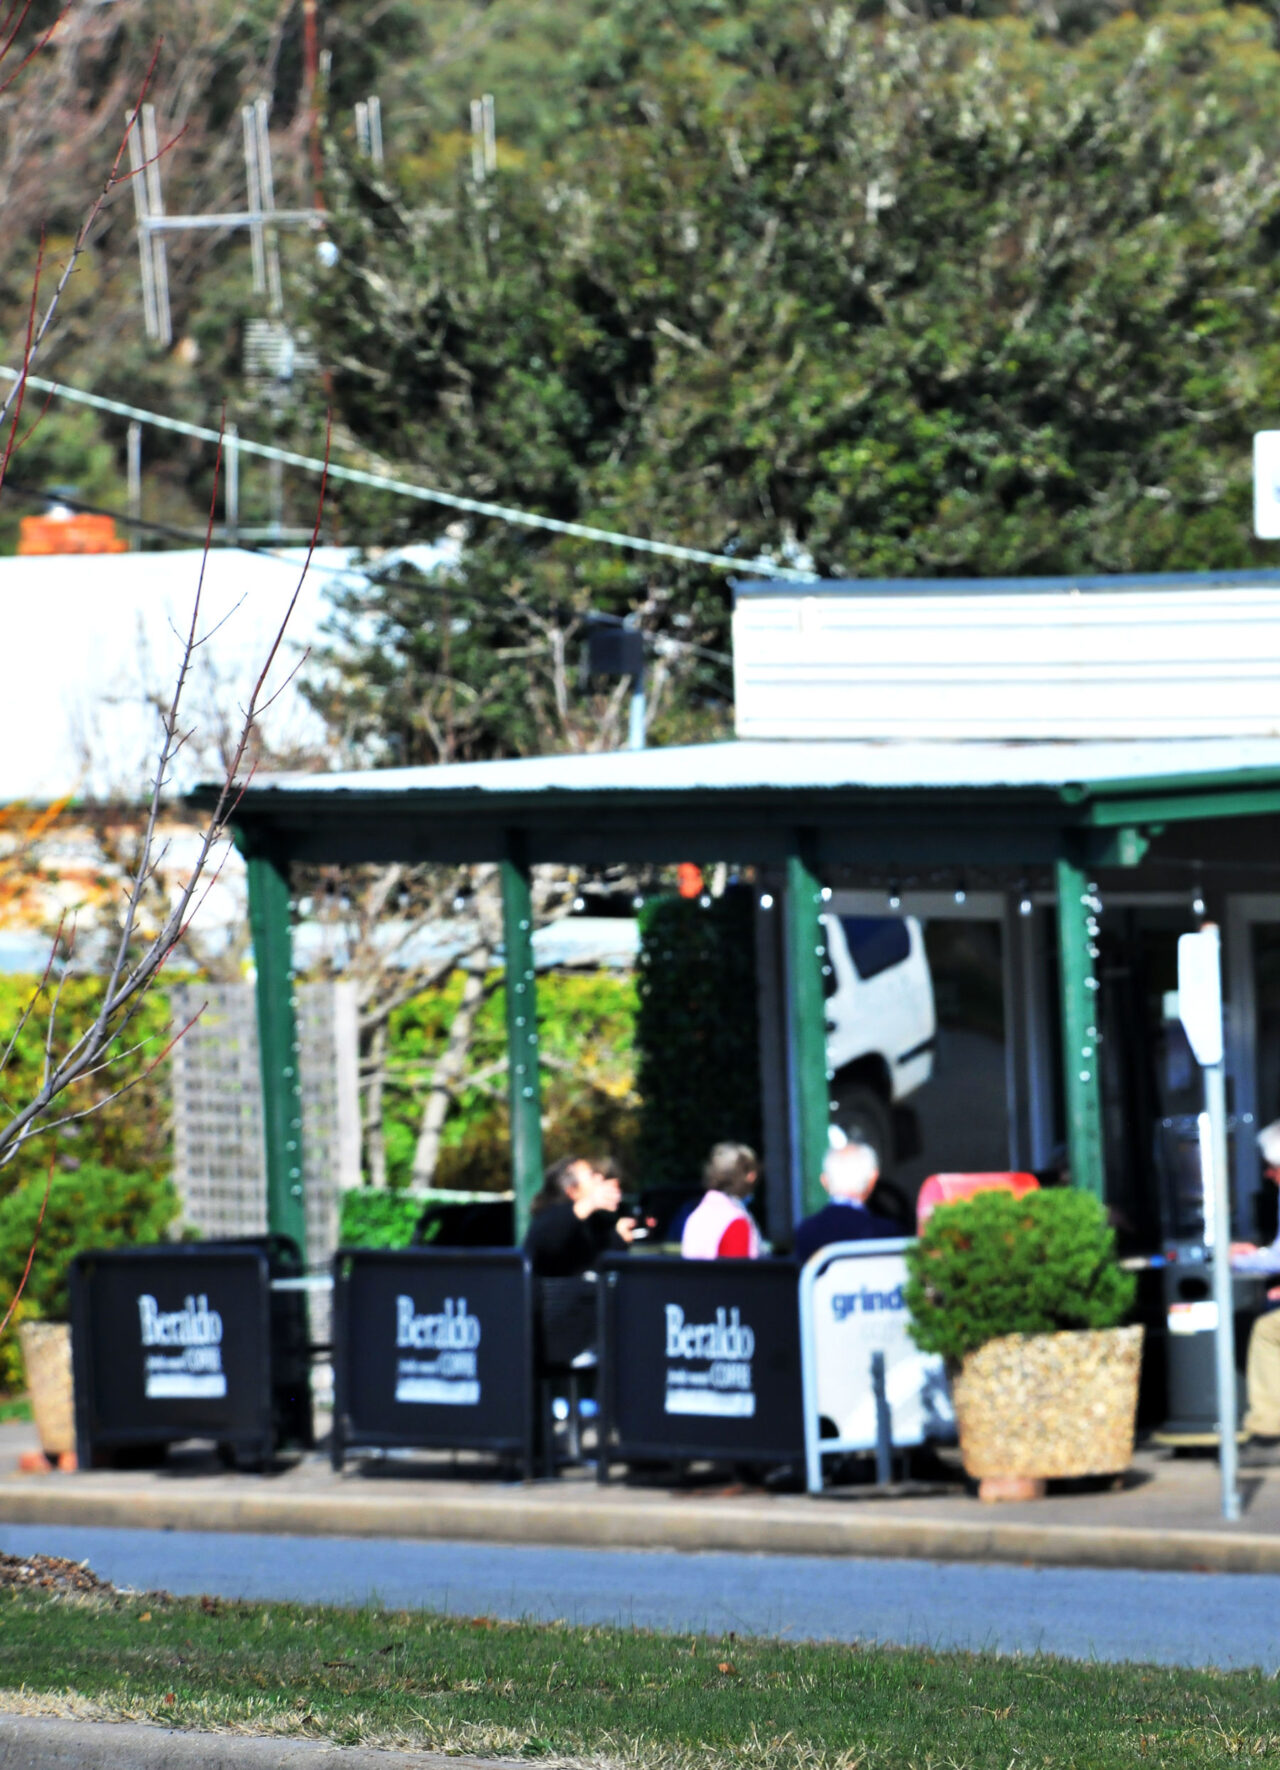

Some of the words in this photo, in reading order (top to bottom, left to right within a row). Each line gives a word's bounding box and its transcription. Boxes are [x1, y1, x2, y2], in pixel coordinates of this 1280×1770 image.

[138, 1293, 223, 1346] Beraldo
[396, 1294, 481, 1349] Beraldo
[665, 1303, 755, 1360] Beraldo
